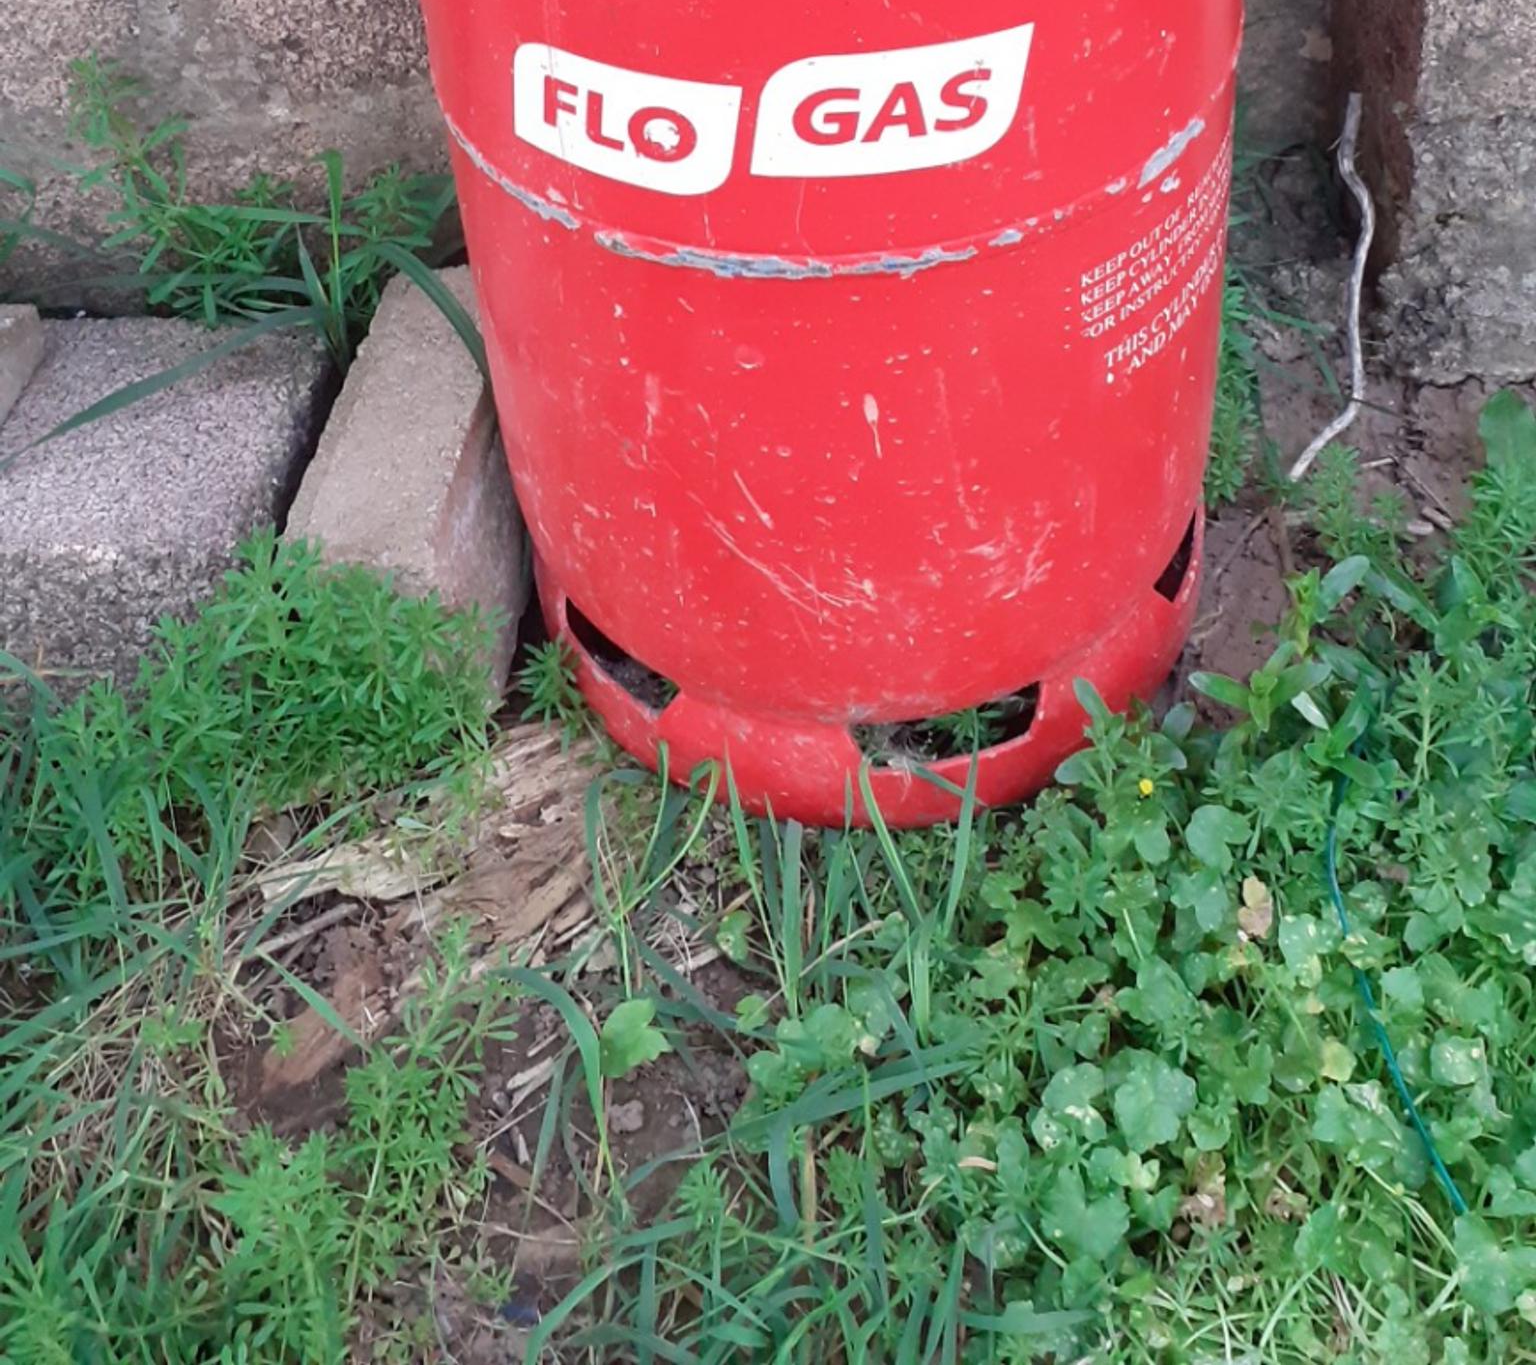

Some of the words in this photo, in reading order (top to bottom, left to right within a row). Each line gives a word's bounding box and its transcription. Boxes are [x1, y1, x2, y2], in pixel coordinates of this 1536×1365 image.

[542, 75, 698, 164] FLO
[792, 67, 993, 147] GAS
[1080, 251, 1127, 288] KEEP
[1129, 223, 1163, 259] OUT
[1080, 270, 1127, 306] KEEP
[1129, 207, 1197, 277] CYLINDER
[1080, 289, 1126, 322] KEEP
[1127, 249, 1174, 299] AWAY
[1103, 325, 1148, 368] THIS
[1126, 330, 1167, 375] AND
[1167, 287, 1200, 342] MAY
